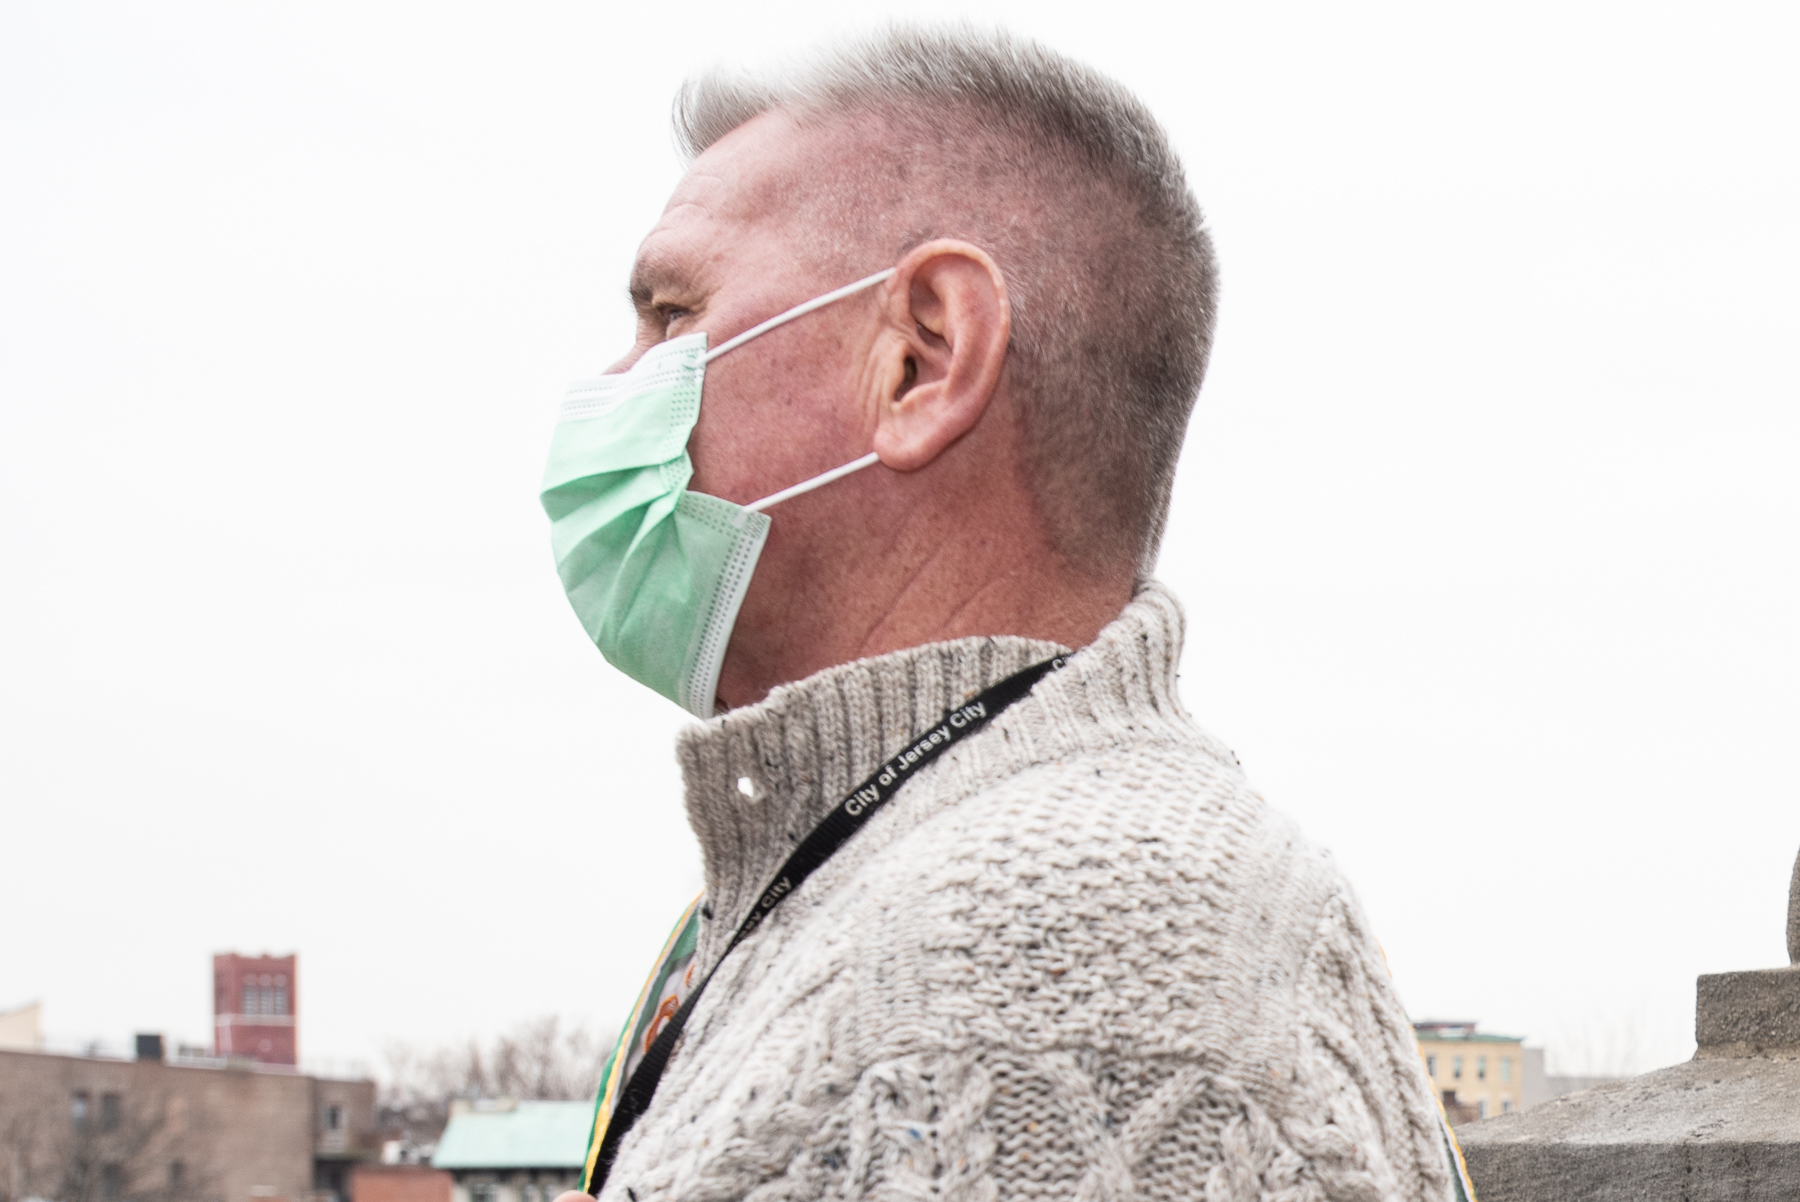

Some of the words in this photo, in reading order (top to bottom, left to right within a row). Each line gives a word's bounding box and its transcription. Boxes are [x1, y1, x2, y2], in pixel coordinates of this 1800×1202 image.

[844, 784, 881, 817] City
[878, 766, 898, 787] of
[897, 725, 951, 769] Jersey
[950, 701, 988, 729] City
[761, 876, 793, 909] City
